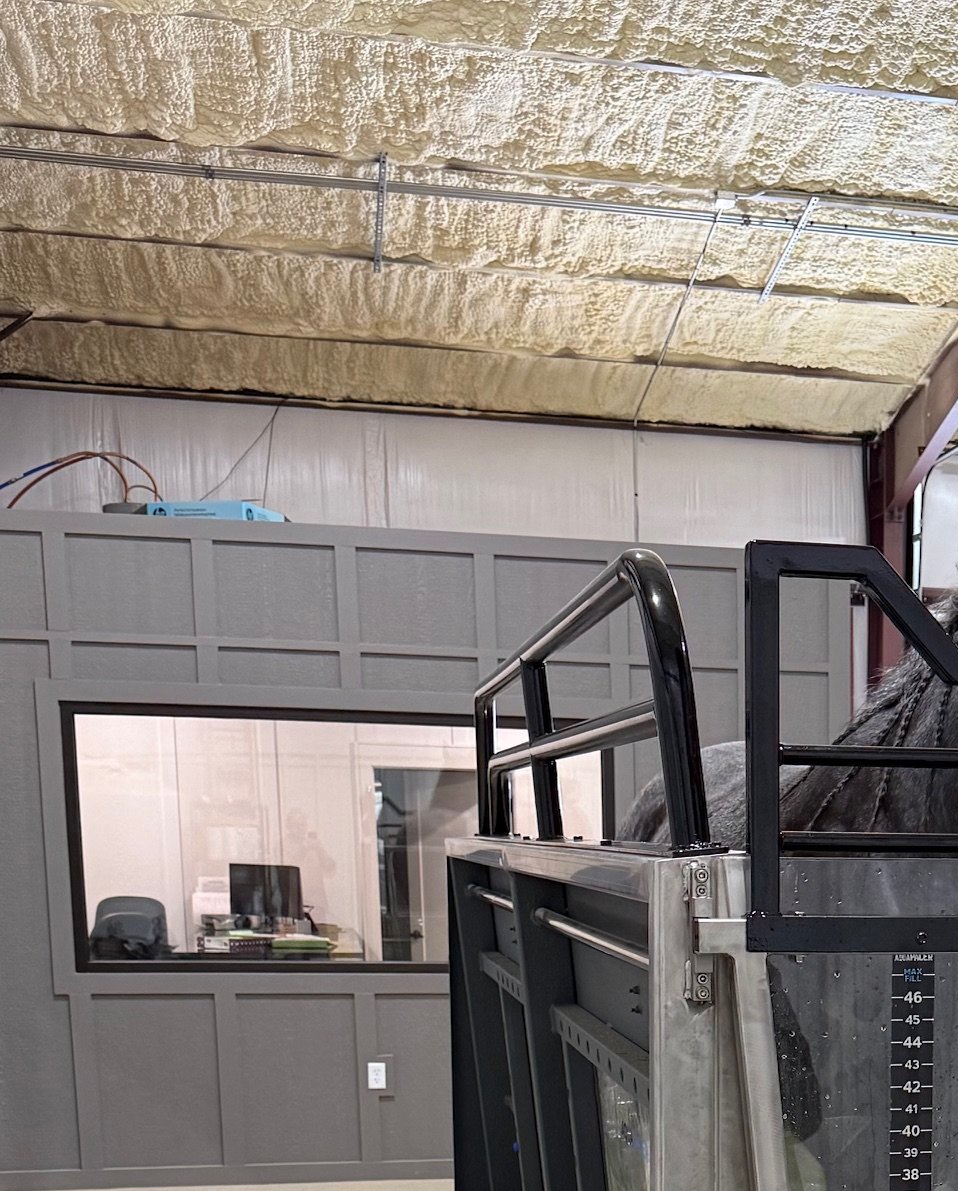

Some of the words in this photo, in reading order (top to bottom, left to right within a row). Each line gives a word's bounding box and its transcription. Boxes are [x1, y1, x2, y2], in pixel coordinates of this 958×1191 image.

[904, 991, 922, 1004] 46
[907, 1015, 919, 1024] 45
[904, 1037, 920, 1048] 44
[906, 1060, 919, 1069] 43
[904, 1081, 920, 1092] 42
[907, 1104, 917, 1113] 41
[903, 1125, 919, 1136] 40
[904, 1148, 917, 1157] 39
[902, 1169, 918, 1180] 38
